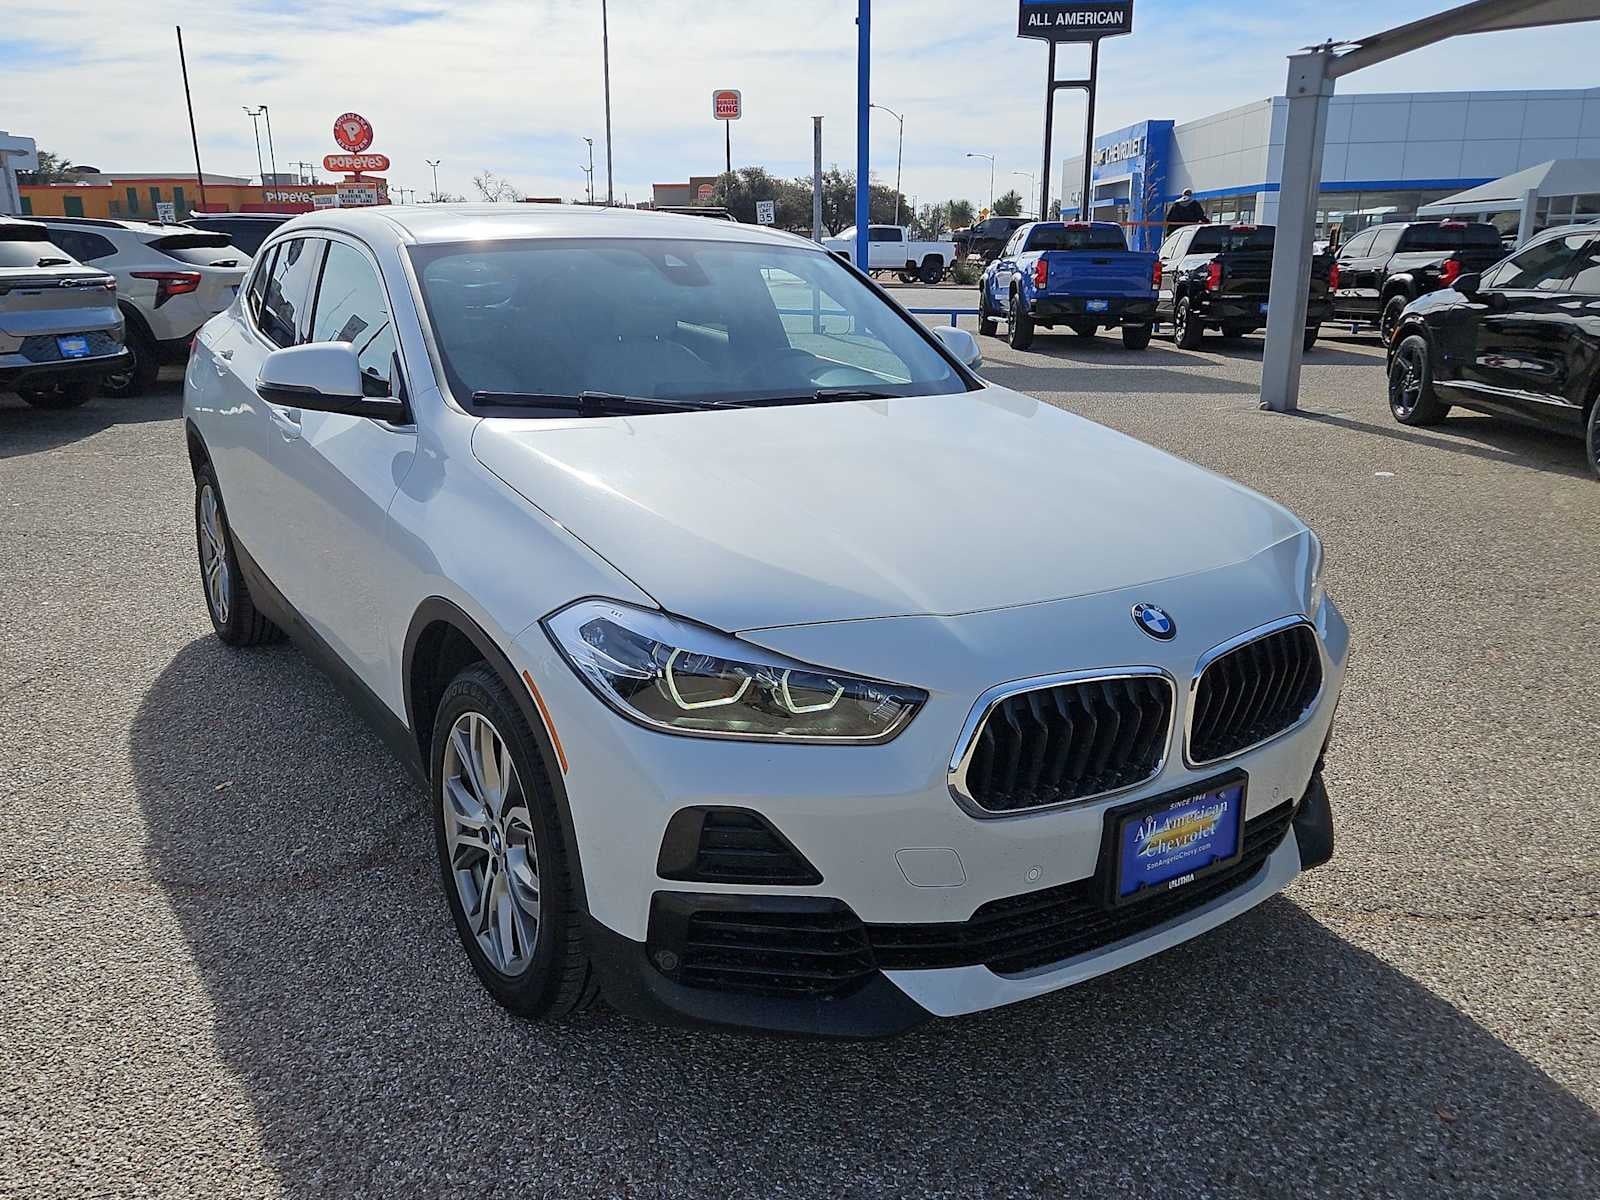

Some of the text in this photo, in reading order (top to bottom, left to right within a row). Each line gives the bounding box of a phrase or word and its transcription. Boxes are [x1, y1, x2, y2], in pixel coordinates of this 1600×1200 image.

[1028, 11, 1124, 26] ALL AMERICAN
[716, 105, 738, 113] KING
[1105, 138, 1142, 164] CHEVROLET
[759, 213, 773, 223] 35
[1169, 798, 1191, 810] SINCE
[1133, 801, 1228, 843] All American
[1146, 822, 1216, 857] Chevrolet
